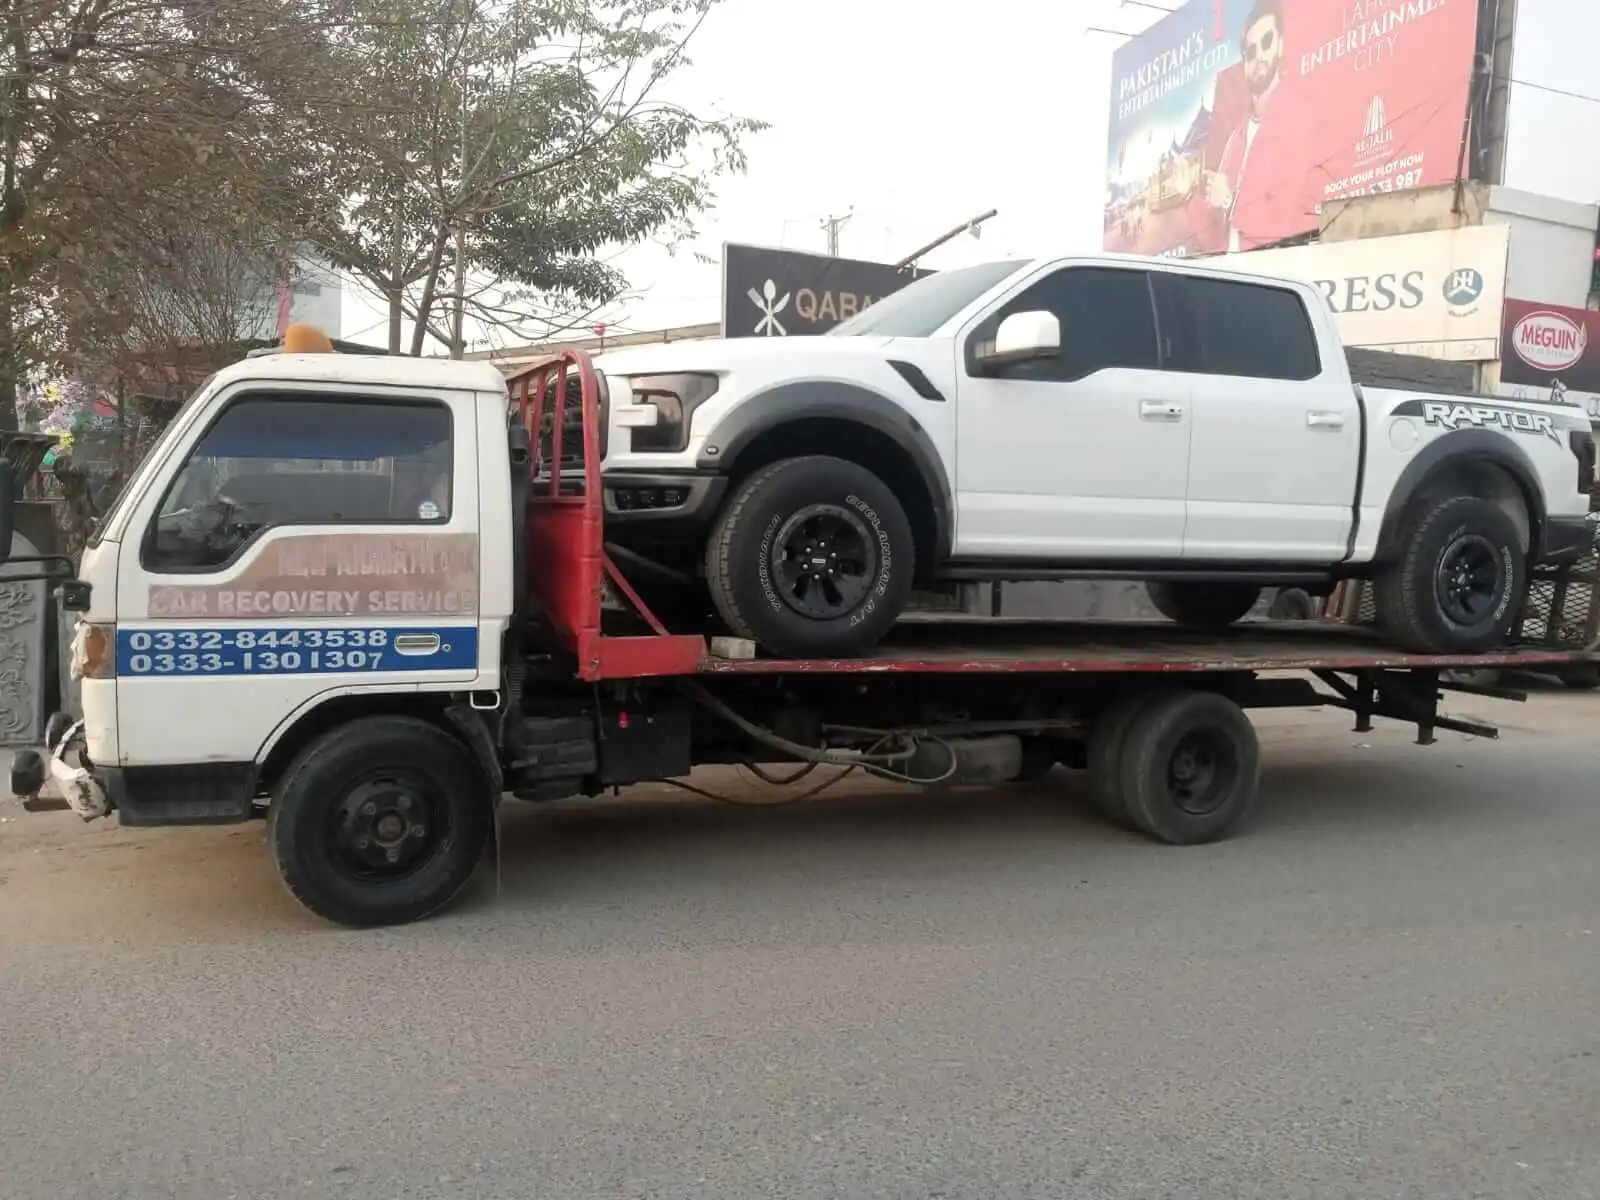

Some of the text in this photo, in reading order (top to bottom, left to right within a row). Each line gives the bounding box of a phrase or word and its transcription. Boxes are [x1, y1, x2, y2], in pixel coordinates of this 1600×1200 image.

[1119, 27, 1204, 101] PAKISTAN'S
[1353, 32, 1400, 72] CITY
[1118, 39, 1231, 120] ENTERTAINMENT CITY
[1349, 168, 1375, 186] YOUR
[1375, 158, 1399, 178] PLOT
[1399, 151, 1425, 171] NOW
[795, 287, 886, 323] QABA
[1422, 400, 1563, 449] RAPTOR
[151, 589, 477, 615] CAR RECOVERY SERVICE
[129, 628, 388, 651] 0332-8443538
[129, 651, 384, 673] 0333-1301307
